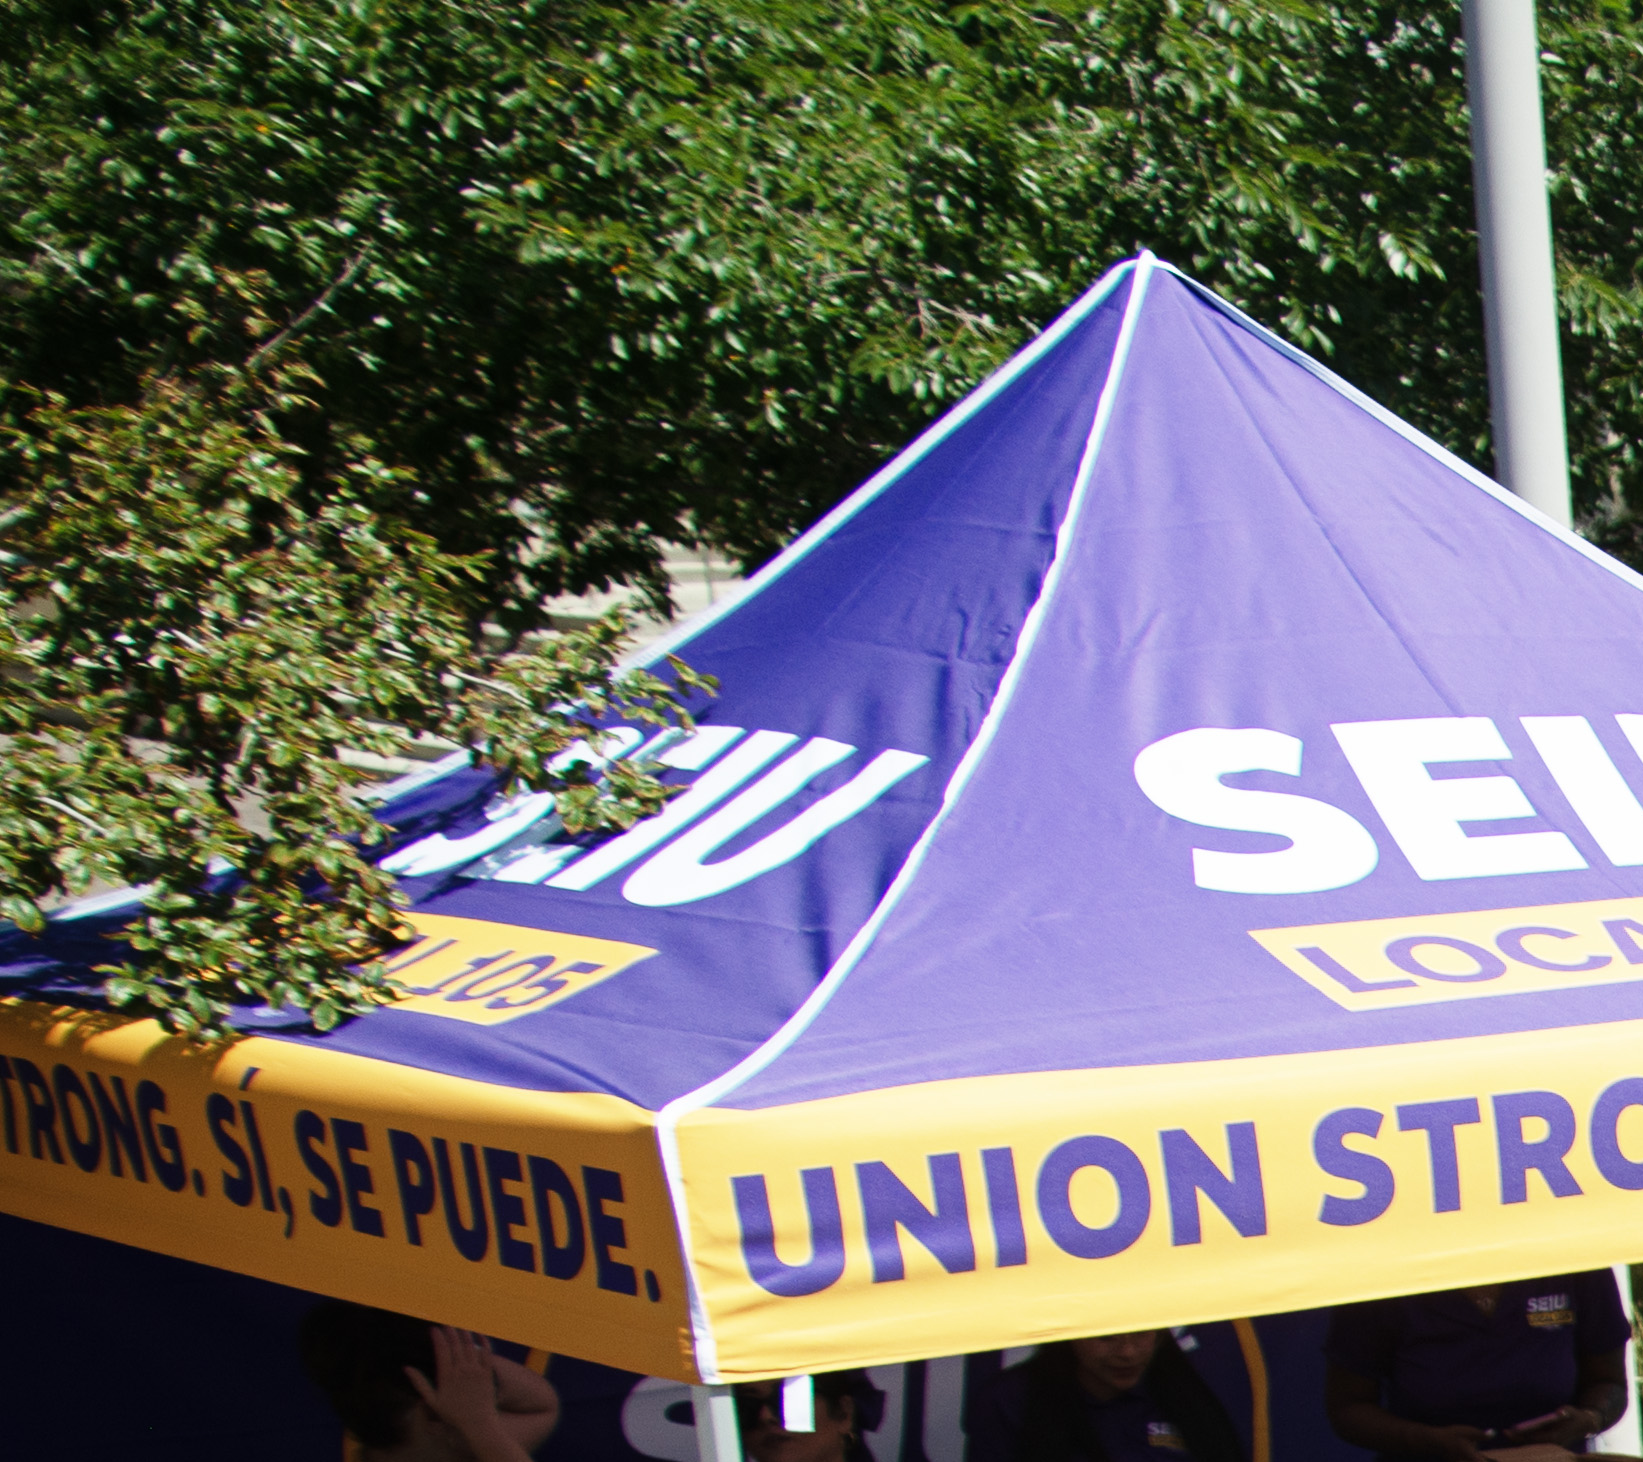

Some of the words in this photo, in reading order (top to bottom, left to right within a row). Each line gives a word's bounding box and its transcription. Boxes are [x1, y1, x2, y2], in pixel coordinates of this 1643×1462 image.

[440, 946, 608, 1011] 105
[0, 1053, 206, 1199] TRONG.
[205, 1066, 295, 1241] SÍ,
[294, 1109, 386, 1240] SE
[386, 1127, 663, 1304] PUEDE.
[730, 1121, 1269, 1299] UNION
